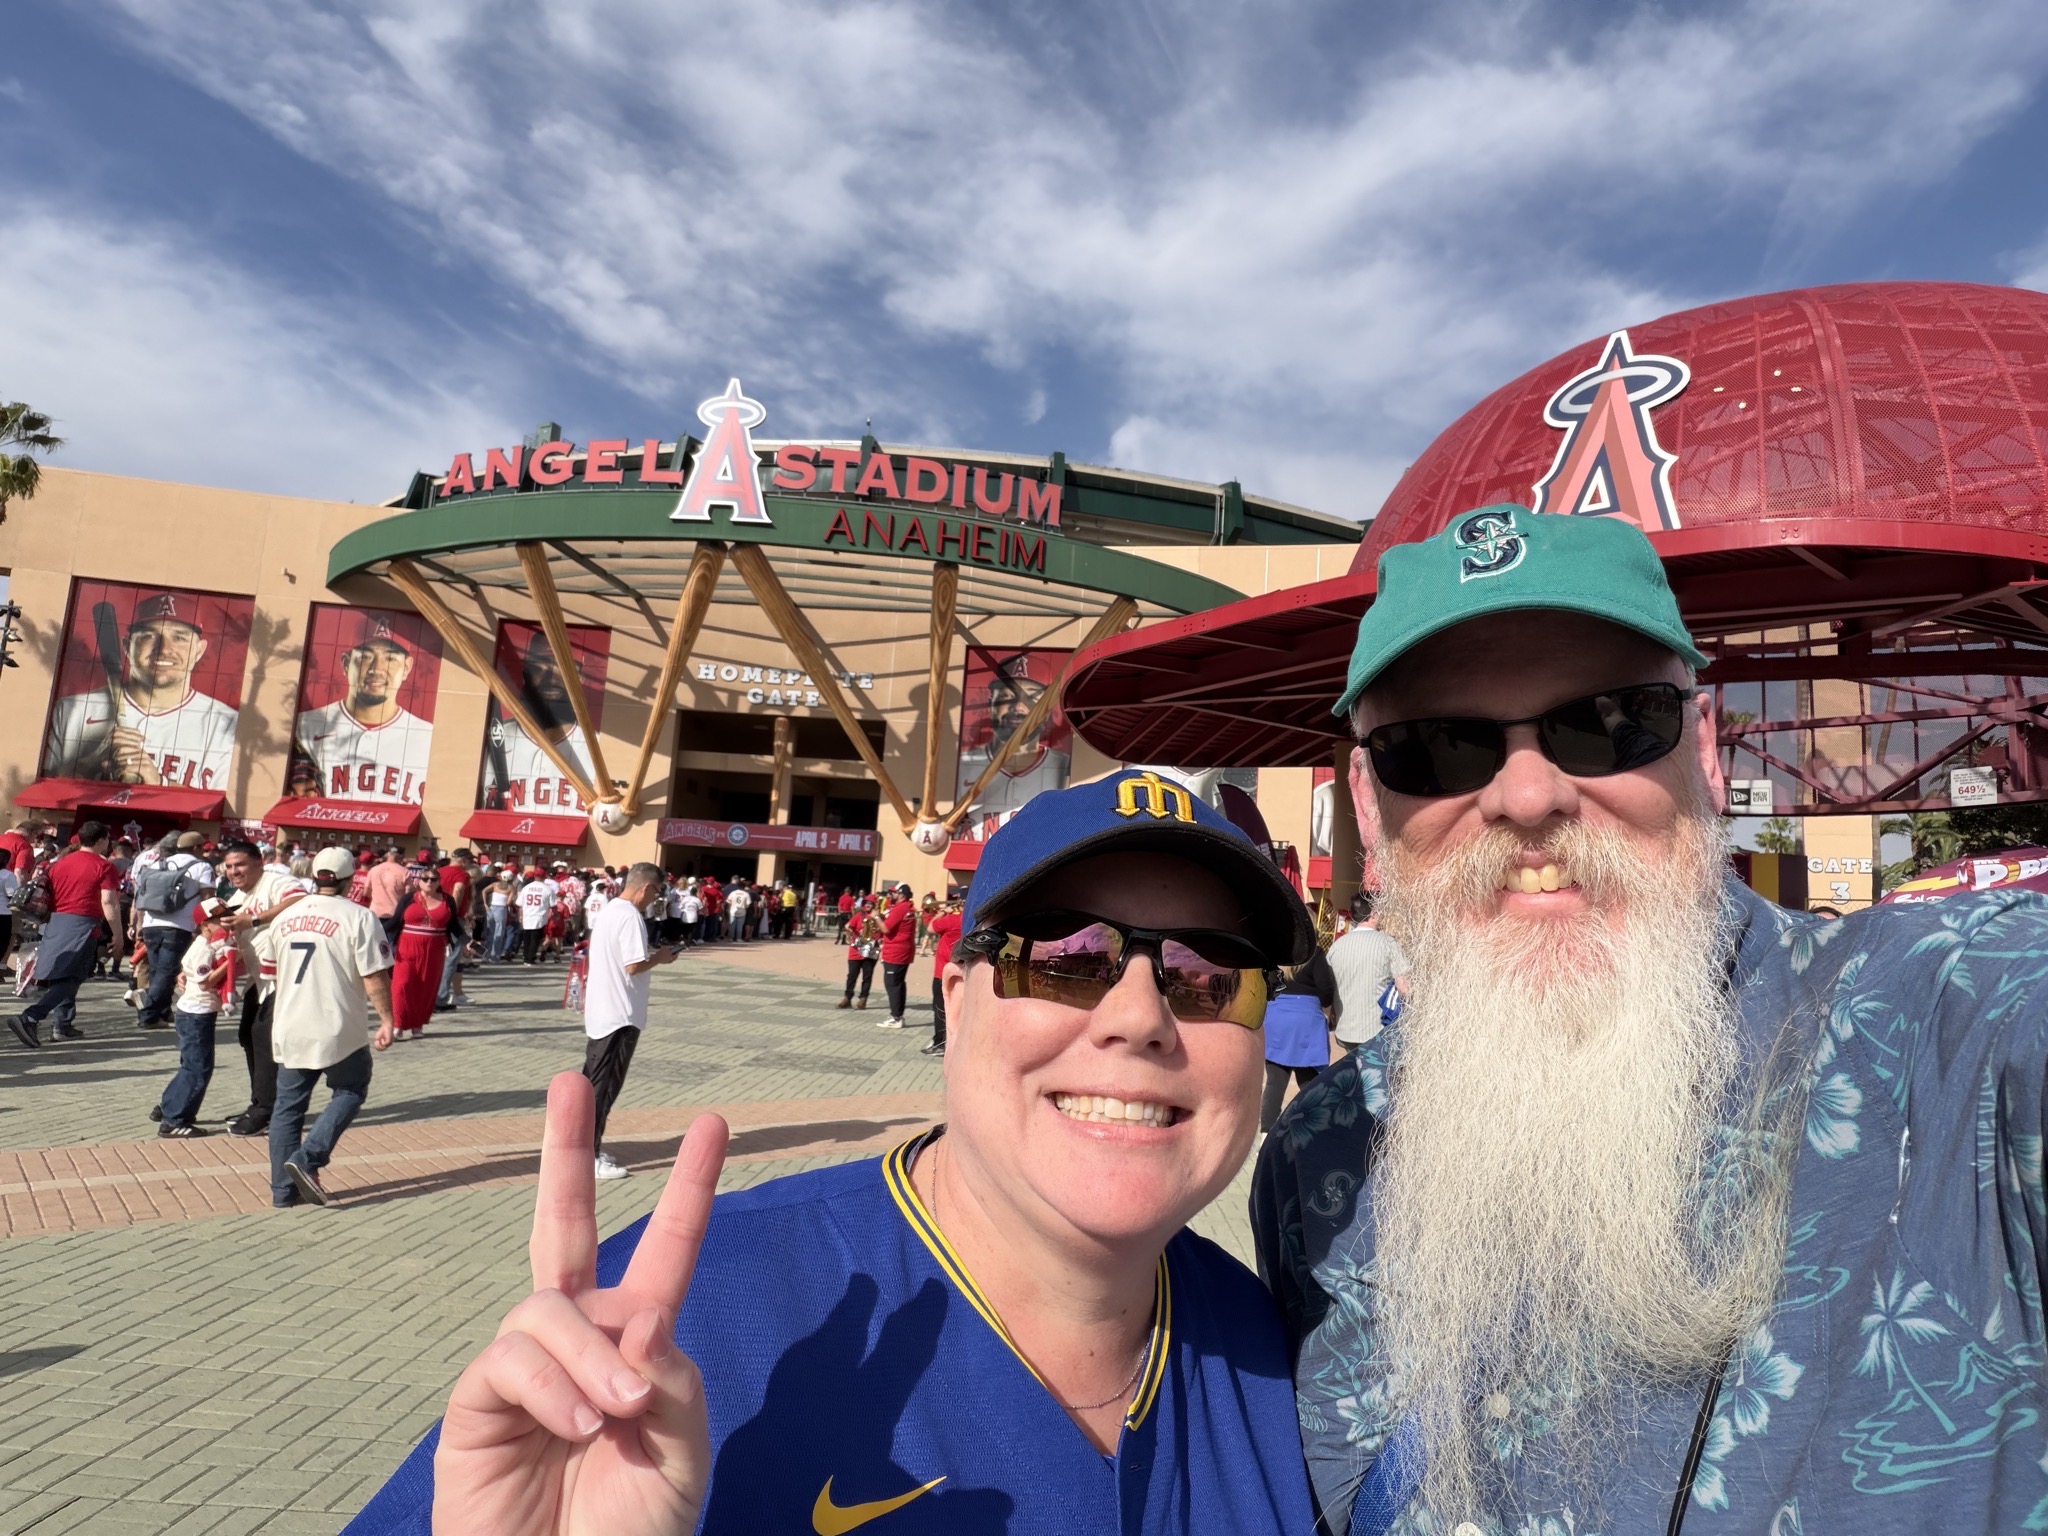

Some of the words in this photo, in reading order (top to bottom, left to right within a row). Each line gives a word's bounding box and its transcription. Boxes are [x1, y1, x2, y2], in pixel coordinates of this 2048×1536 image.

[441, 438, 684, 497] ANGEL
[773, 445, 1063, 527] STADIUM
[823, 507, 1045, 570] ANAHEIM
[747, 688, 820, 707] GATE
[295, 802, 389, 825] ANGELS
[301, 831, 395, 846] TICKETS
[661, 821, 716, 844] ANGELS
[794, 830, 818, 848] APRIL
[820, 832, 828, 849] 3
[838, 832, 861, 851] APRIL
[864, 834, 871, 852] 5
[484, 843, 572, 857] TICKETS
[1807, 857, 1873, 874] GATE
[526, 894, 542, 906] 95
[1830, 881, 1851, 905] 3
[280, 915, 340, 938] ESCOBEDO
[290, 941, 317, 985] 7
